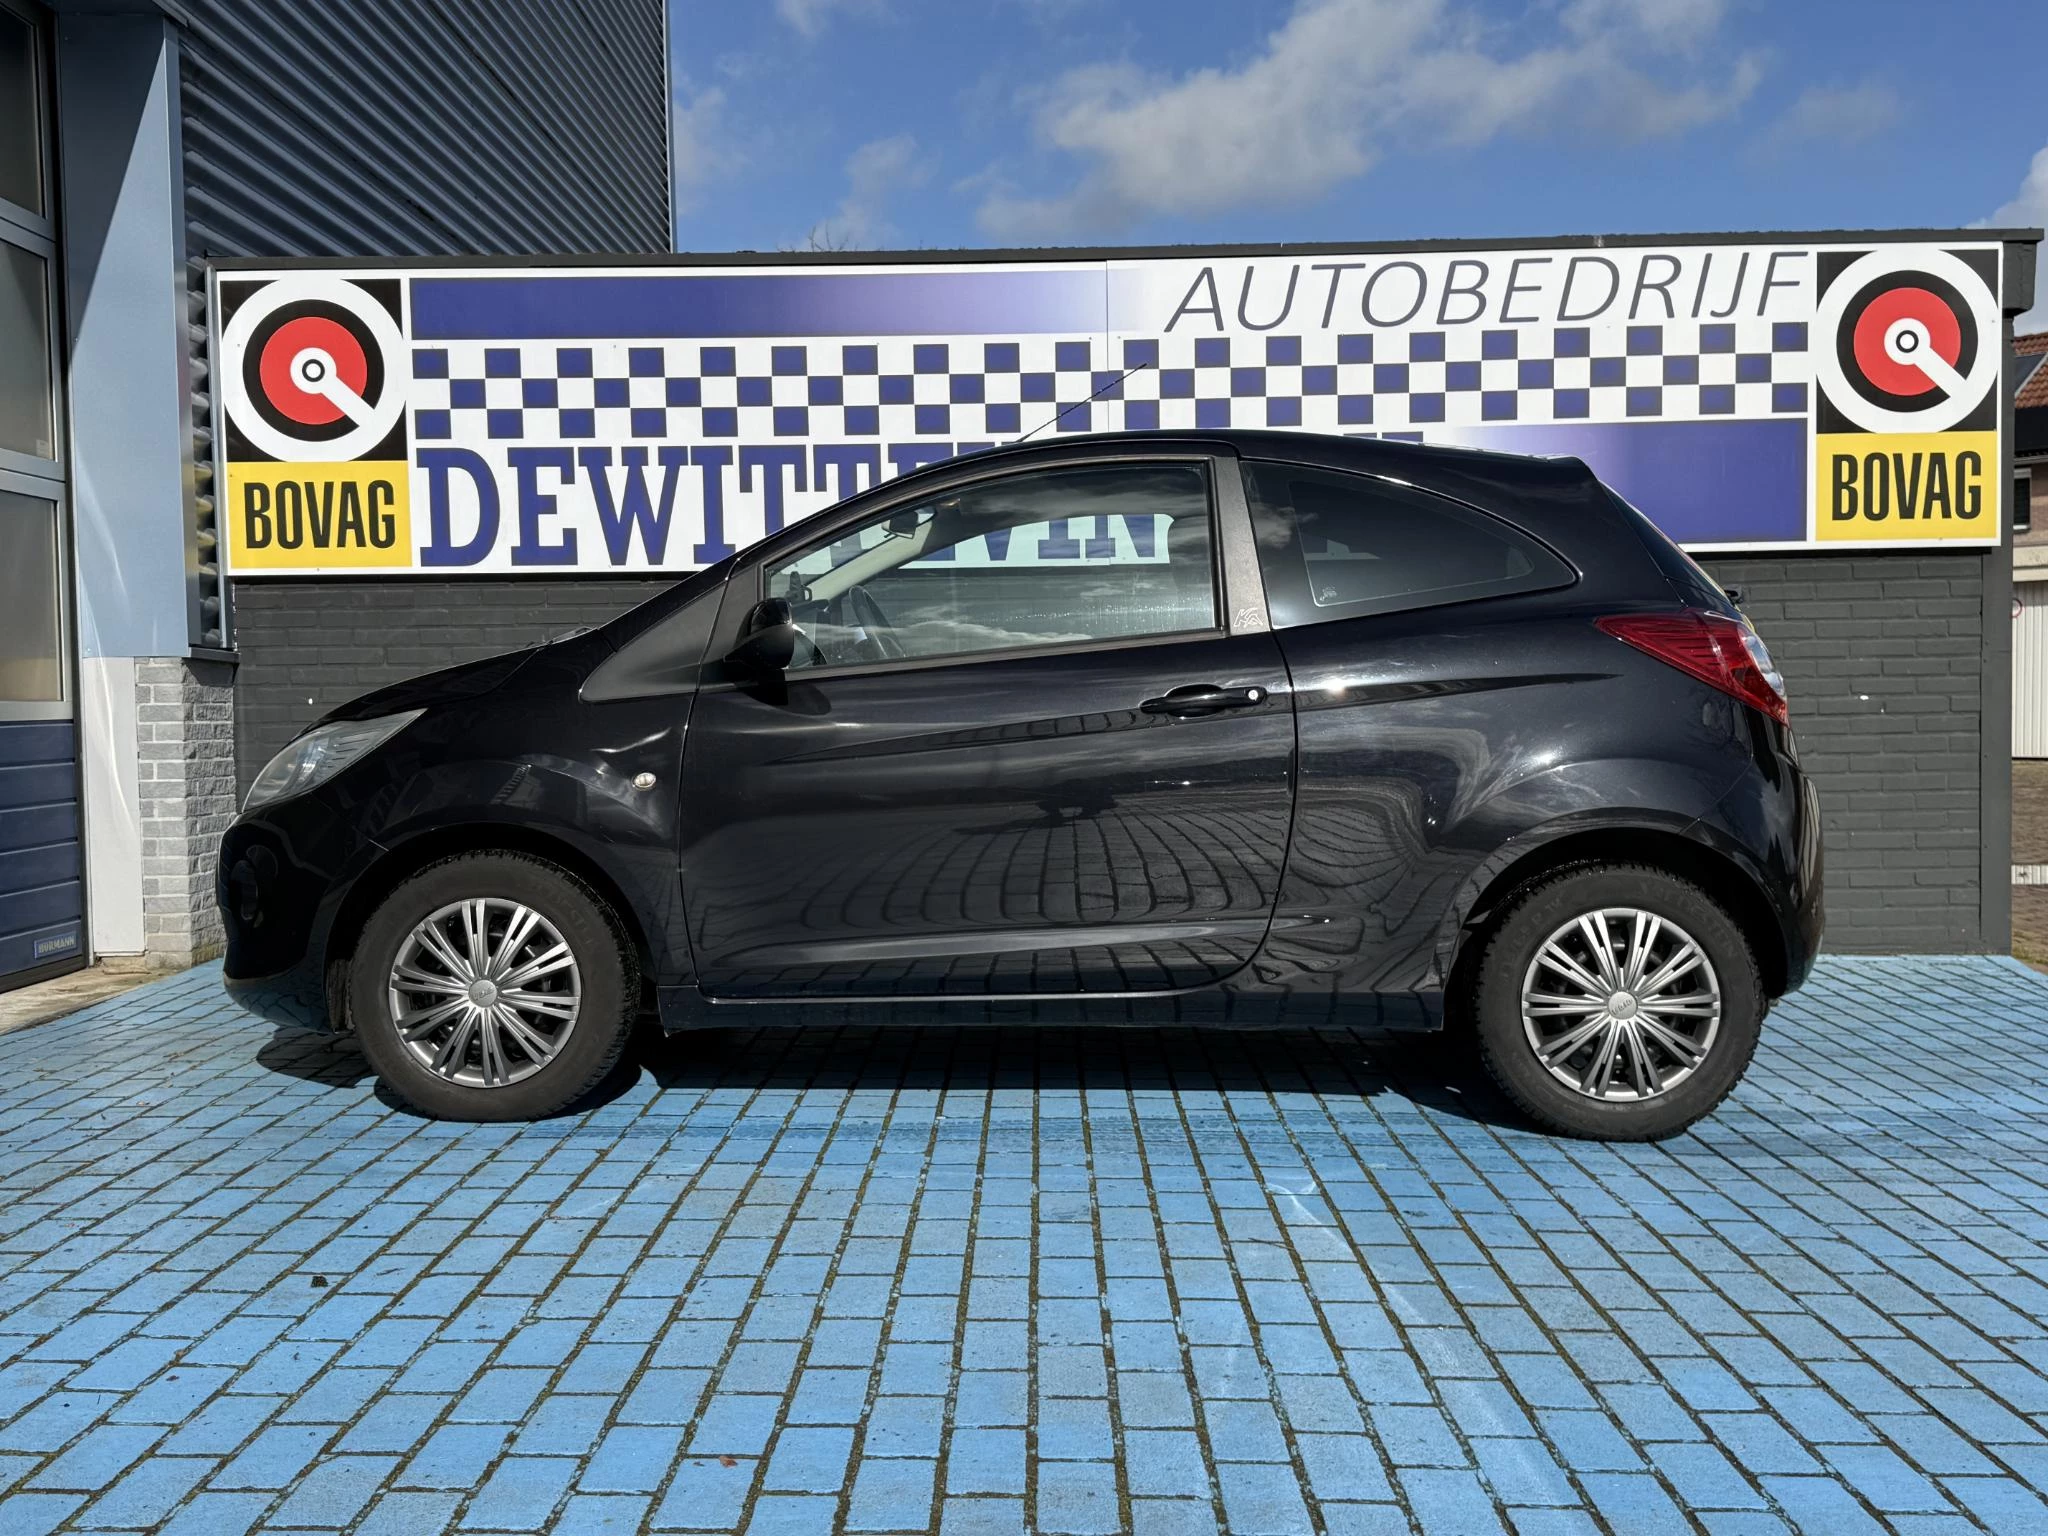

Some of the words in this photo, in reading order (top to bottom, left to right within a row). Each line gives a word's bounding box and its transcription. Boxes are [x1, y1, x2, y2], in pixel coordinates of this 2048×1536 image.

[1164, 252, 1808, 332] AUTOBEDRIJF
[245, 480, 395, 549] BOVAG
[1833, 451, 1981, 520] BOVAG
